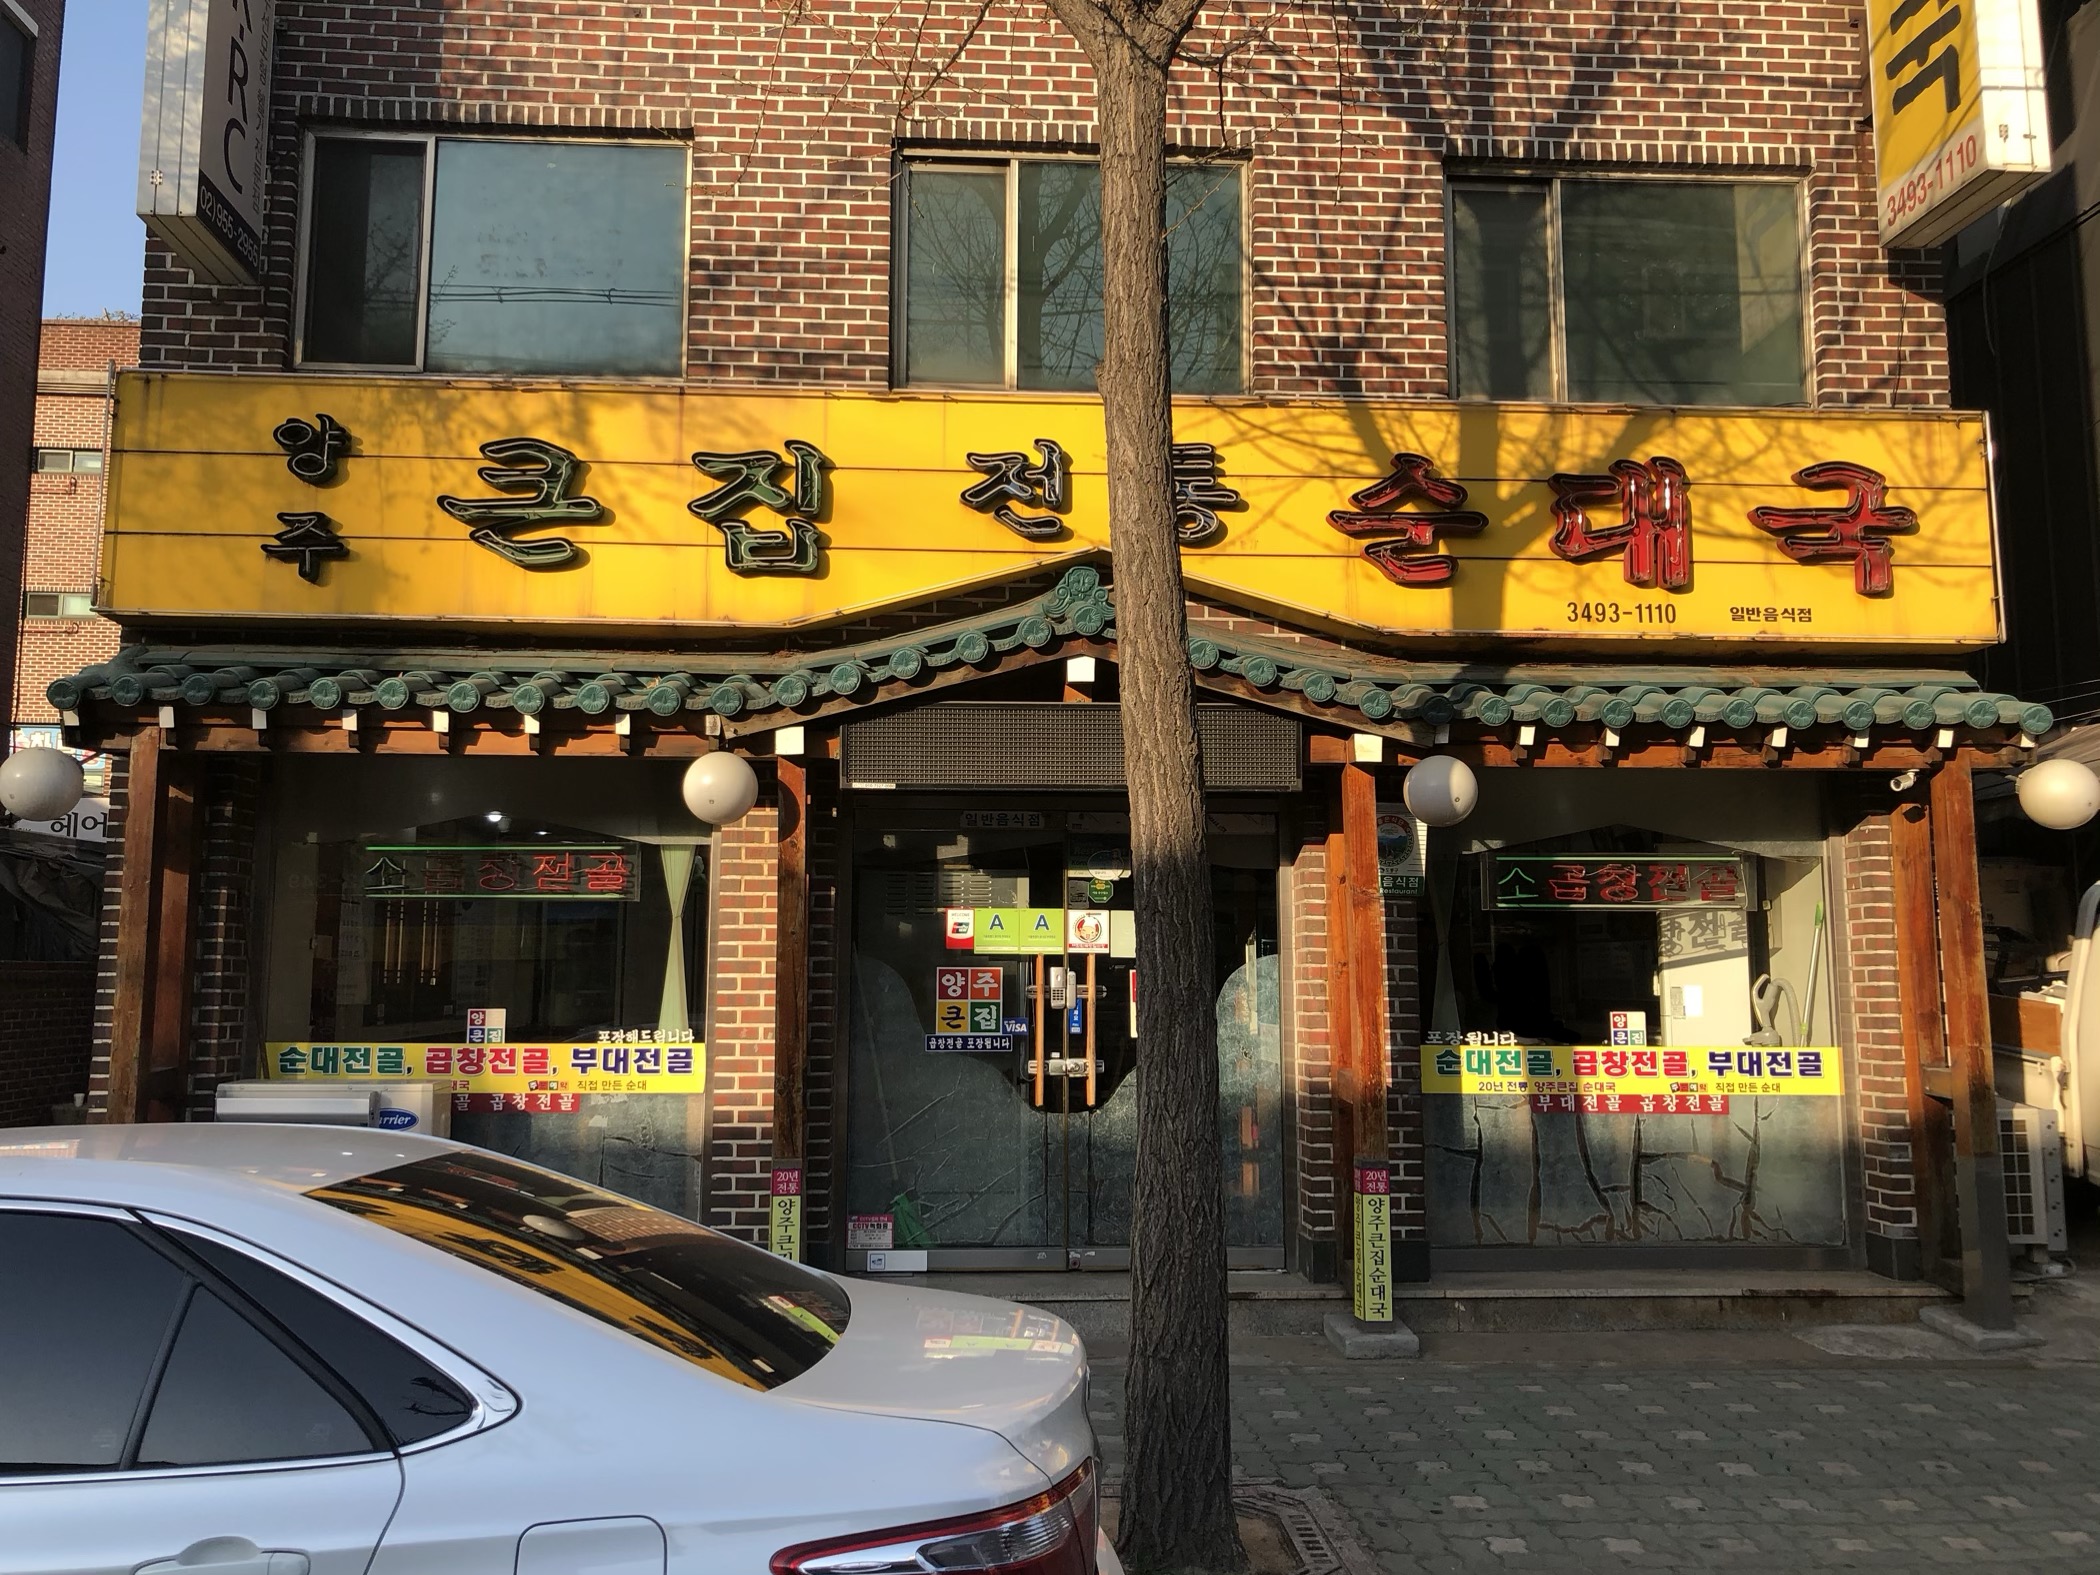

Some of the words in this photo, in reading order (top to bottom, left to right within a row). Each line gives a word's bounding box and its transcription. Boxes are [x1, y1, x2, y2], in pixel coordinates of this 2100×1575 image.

[1886, 134, 1977, 227] 3493-1110
[199, 189, 260, 268] 02)955-2955
[260, 413, 352, 586] 양주
[1328, 452, 1917, 596] 순대국
[1566, 602, 1677, 624] 3493-1110
[1729, 606, 1813, 625] 일반음식점
[964, 813, 1041, 827] 일반음식점
[1382, 875, 1419, 888] 음식점
[1380, 887, 1418, 895] Restaurant
[989, 914, 1004, 930] A
[1034, 914, 1050, 930] A
[941, 971, 999, 997] 양주
[471, 1011, 485, 1025] 양
[940, 1005, 997, 1030] 큰집
[1613, 1014, 1627, 1028] 양
[1005, 1023, 1027, 1032] VISA
[470, 1029, 502, 1043] 큰집
[597, 1028, 695, 1043] 포장해드립니다
[928, 1037, 964, 1049] 곱창전골
[966, 1037, 1010, 1049] 포장됩니다
[1425, 1030, 1518, 1046] 포장됩니다
[1613, 1031, 1645, 1046] 큰집
[279, 1046, 415, 1076] 순대전골,
[425, 1046, 558, 1076] 곱창전골,
[570, 1046, 696, 1076] 부대전골
[1435, 1049, 1562, 1077] 순대전골,
[1571, 1049, 1699, 1077] 곱창전골,
[1707, 1050, 1825, 1077] 부대전골
[577, 1080, 598, 1091] 직접
[601, 1080, 622, 1091] 만든
[626, 1080, 647, 1090] 순대
[1478, 1081, 1503, 1092] 20년
[1507, 1081, 1529, 1092] 전통
[1534, 1082, 1578, 1092] 양주큰집
[1583, 1082, 1616, 1092] 순대국
[1715, 1082, 1735, 1093] 직접
[1738, 1082, 1758, 1092] 만든
[1761, 1082, 1781, 1092] 순대
[490, 1093, 575, 1111] 곱창전골
[1536, 1094, 1622, 1113] 부대전골
[1639, 1094, 1725, 1112] 곱창전골
[776, 1170, 798, 1182] 20년
[1365, 1170, 1387, 1181] 20년
[776, 1182, 798, 1193] 전통
[1365, 1182, 1387, 1193] 전통
[1367, 1197, 1388, 1319] 양주큰집순대국
